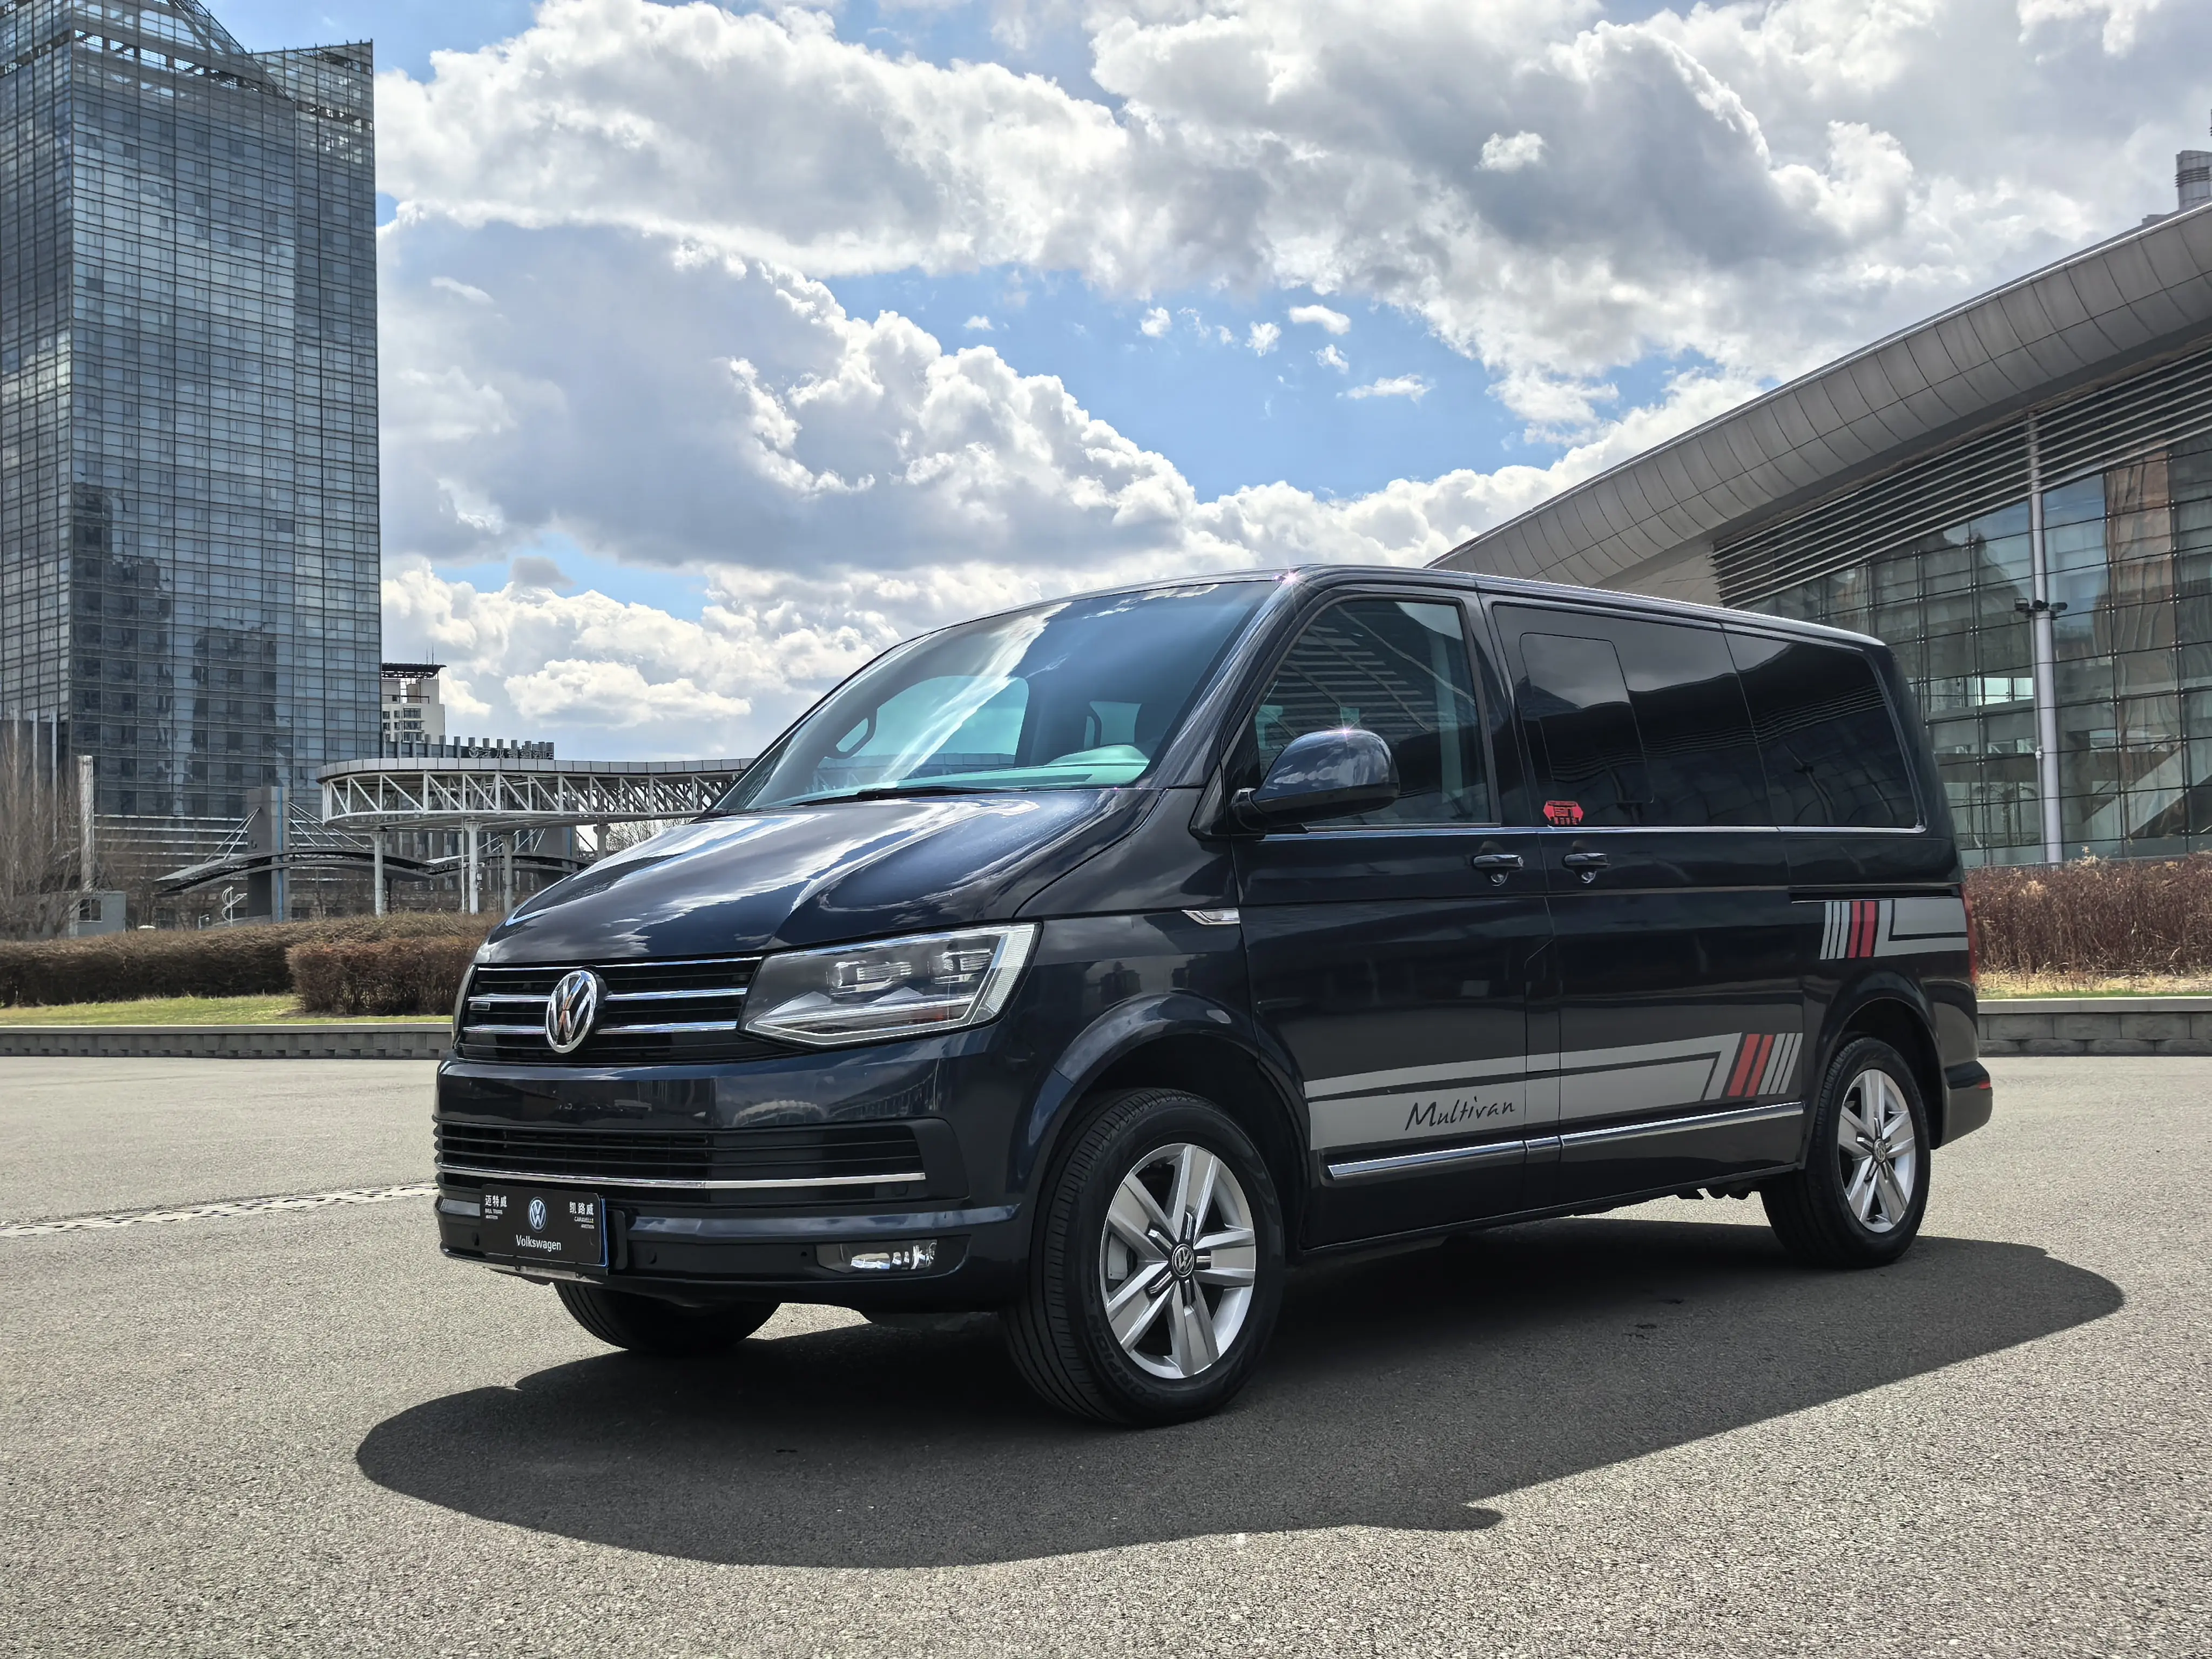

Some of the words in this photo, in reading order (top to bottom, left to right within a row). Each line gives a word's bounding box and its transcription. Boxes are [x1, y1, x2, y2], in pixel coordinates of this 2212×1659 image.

[1405, 1096, 1515, 1130] Multivan
[485, 1195, 507, 1208] 迈特威
[570, 1201, 594, 1216] 凯路威
[516, 1235, 561, 1252] Volkswagen
